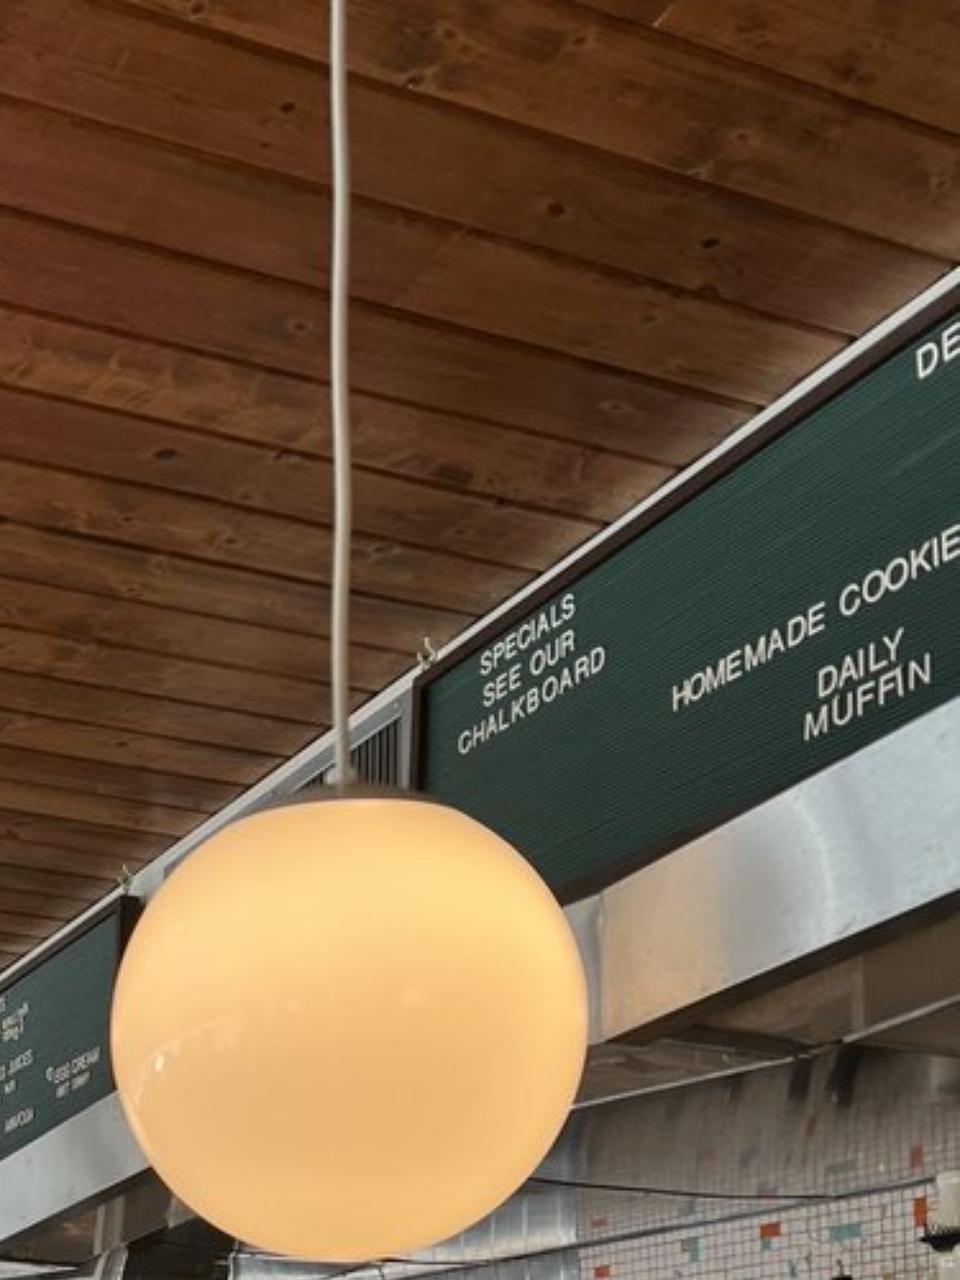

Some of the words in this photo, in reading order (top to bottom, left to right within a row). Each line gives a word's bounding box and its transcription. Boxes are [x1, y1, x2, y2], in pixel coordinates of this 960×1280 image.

[480, 593, 576, 675] SPECIALS
[672, 601, 826, 713] HOMEMADE
[839, 523, 960, 617] COOKIE
[457, 646, 606, 754] CHALKBOARD
[482, 663, 522, 707] SEE
[529, 629, 575, 676] OUR
[803, 652, 931, 741] MUFFIN
[818, 626, 905, 699] DAILY
